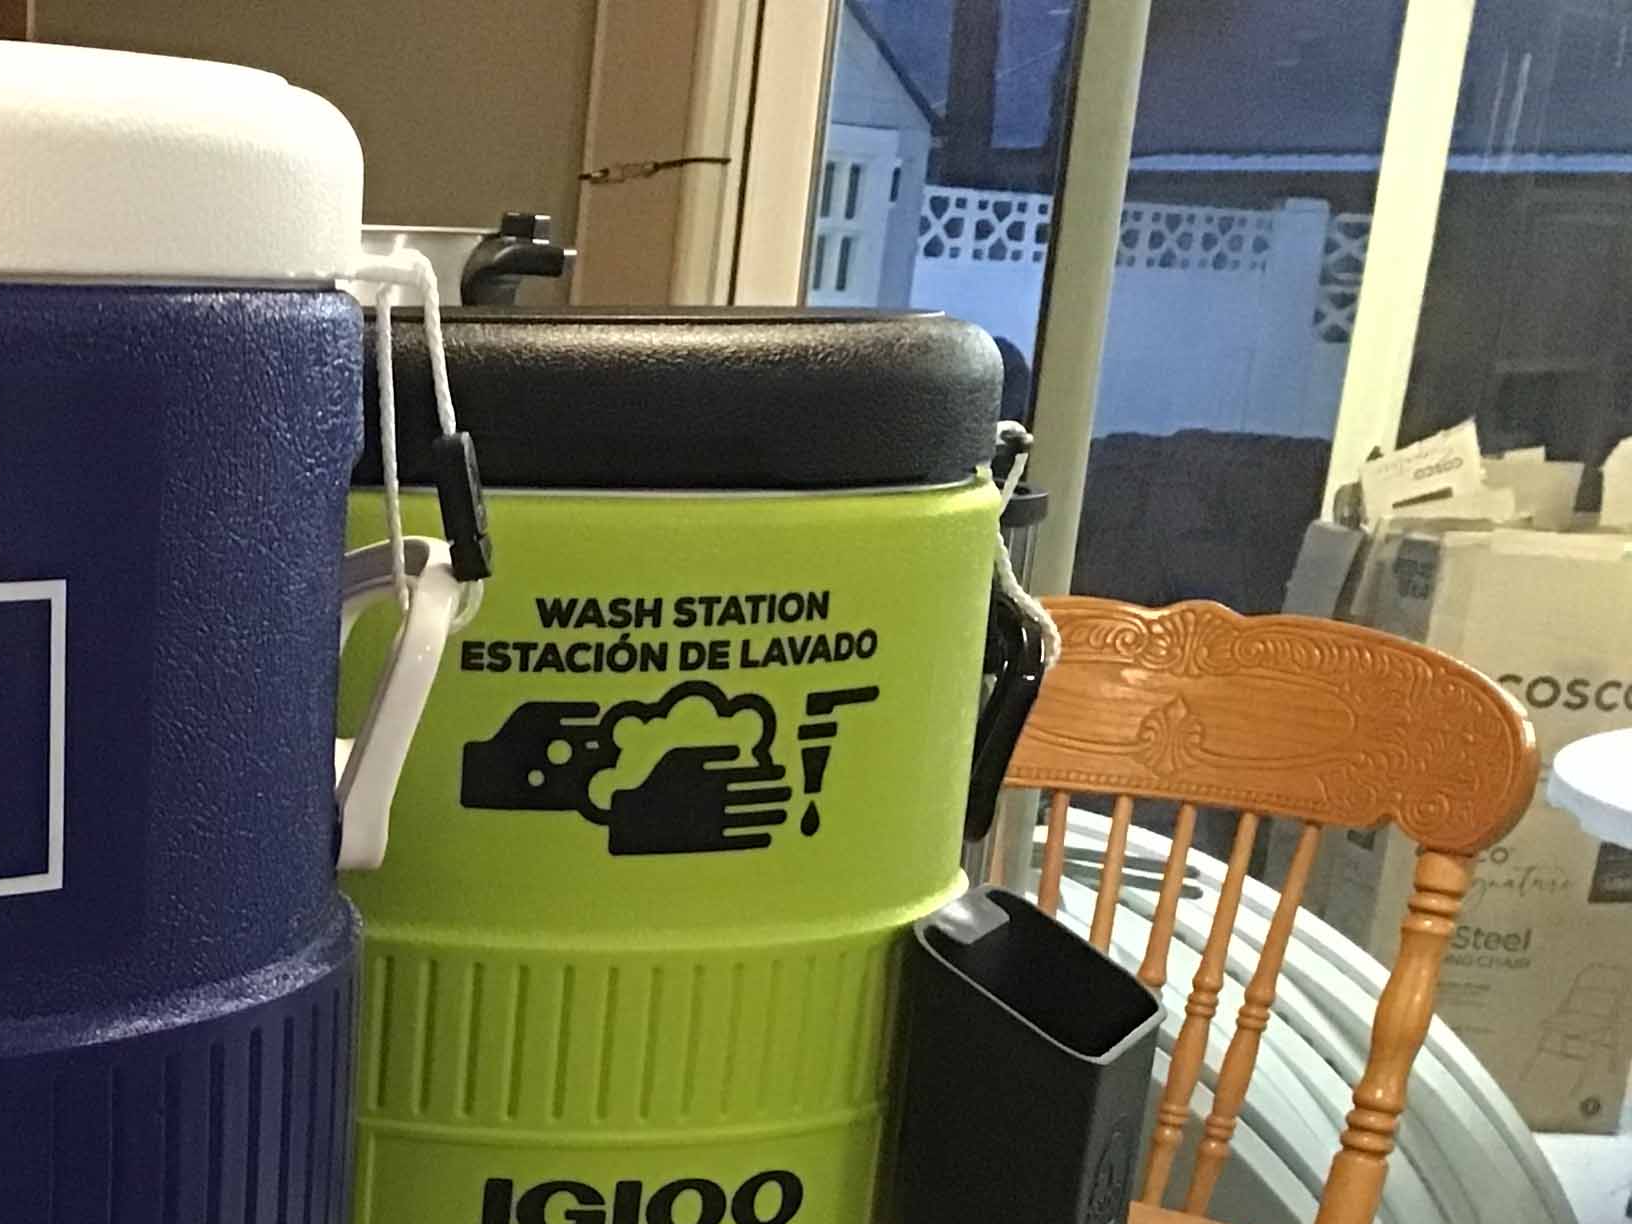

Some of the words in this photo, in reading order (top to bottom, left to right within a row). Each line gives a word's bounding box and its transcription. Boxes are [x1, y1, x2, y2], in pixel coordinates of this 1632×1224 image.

[536, 597, 663, 629] WASH
[673, 591, 830, 628] STATION
[460, 633, 668, 673] ESTACIÓN
[678, 639, 731, 671] DE
[740, 628, 879, 669] LAVADO
[1498, 673, 1632, 712] OSC
[1451, 925, 1532, 952] Steel
